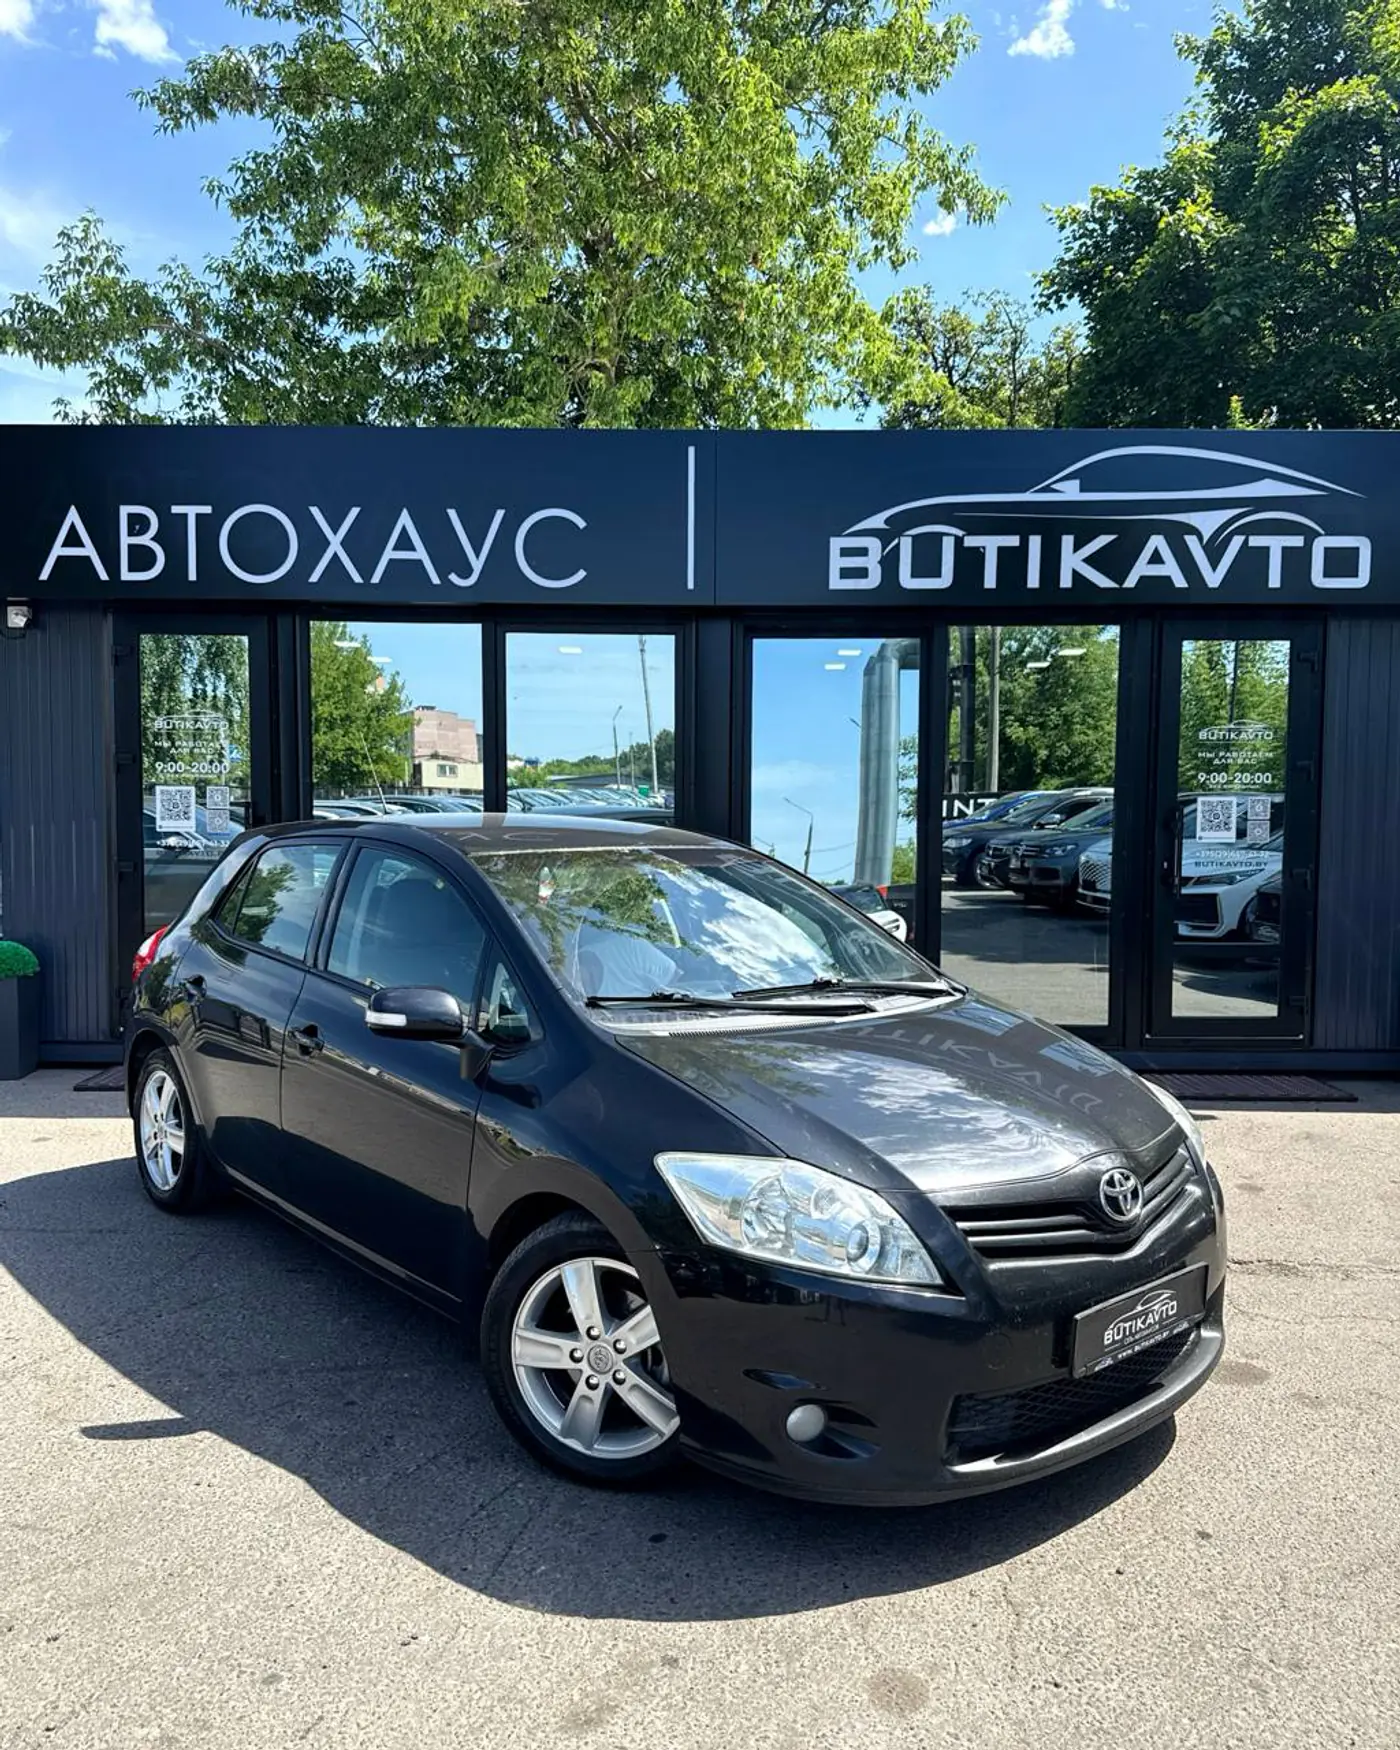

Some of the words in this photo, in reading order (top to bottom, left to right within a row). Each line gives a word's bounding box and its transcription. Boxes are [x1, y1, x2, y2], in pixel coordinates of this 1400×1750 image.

[38, 503, 588, 589] АВТОХАУС
[828, 534, 1372, 590] BUTIKAVTO
[154, 719, 229, 730] BUTIKAVTO
[1198, 731, 1273, 740] BUTIKAVTO
[1197, 772, 1272, 784] 9:00-20:00
[1103, 1300, 1178, 1345] BUTIKAVTO
